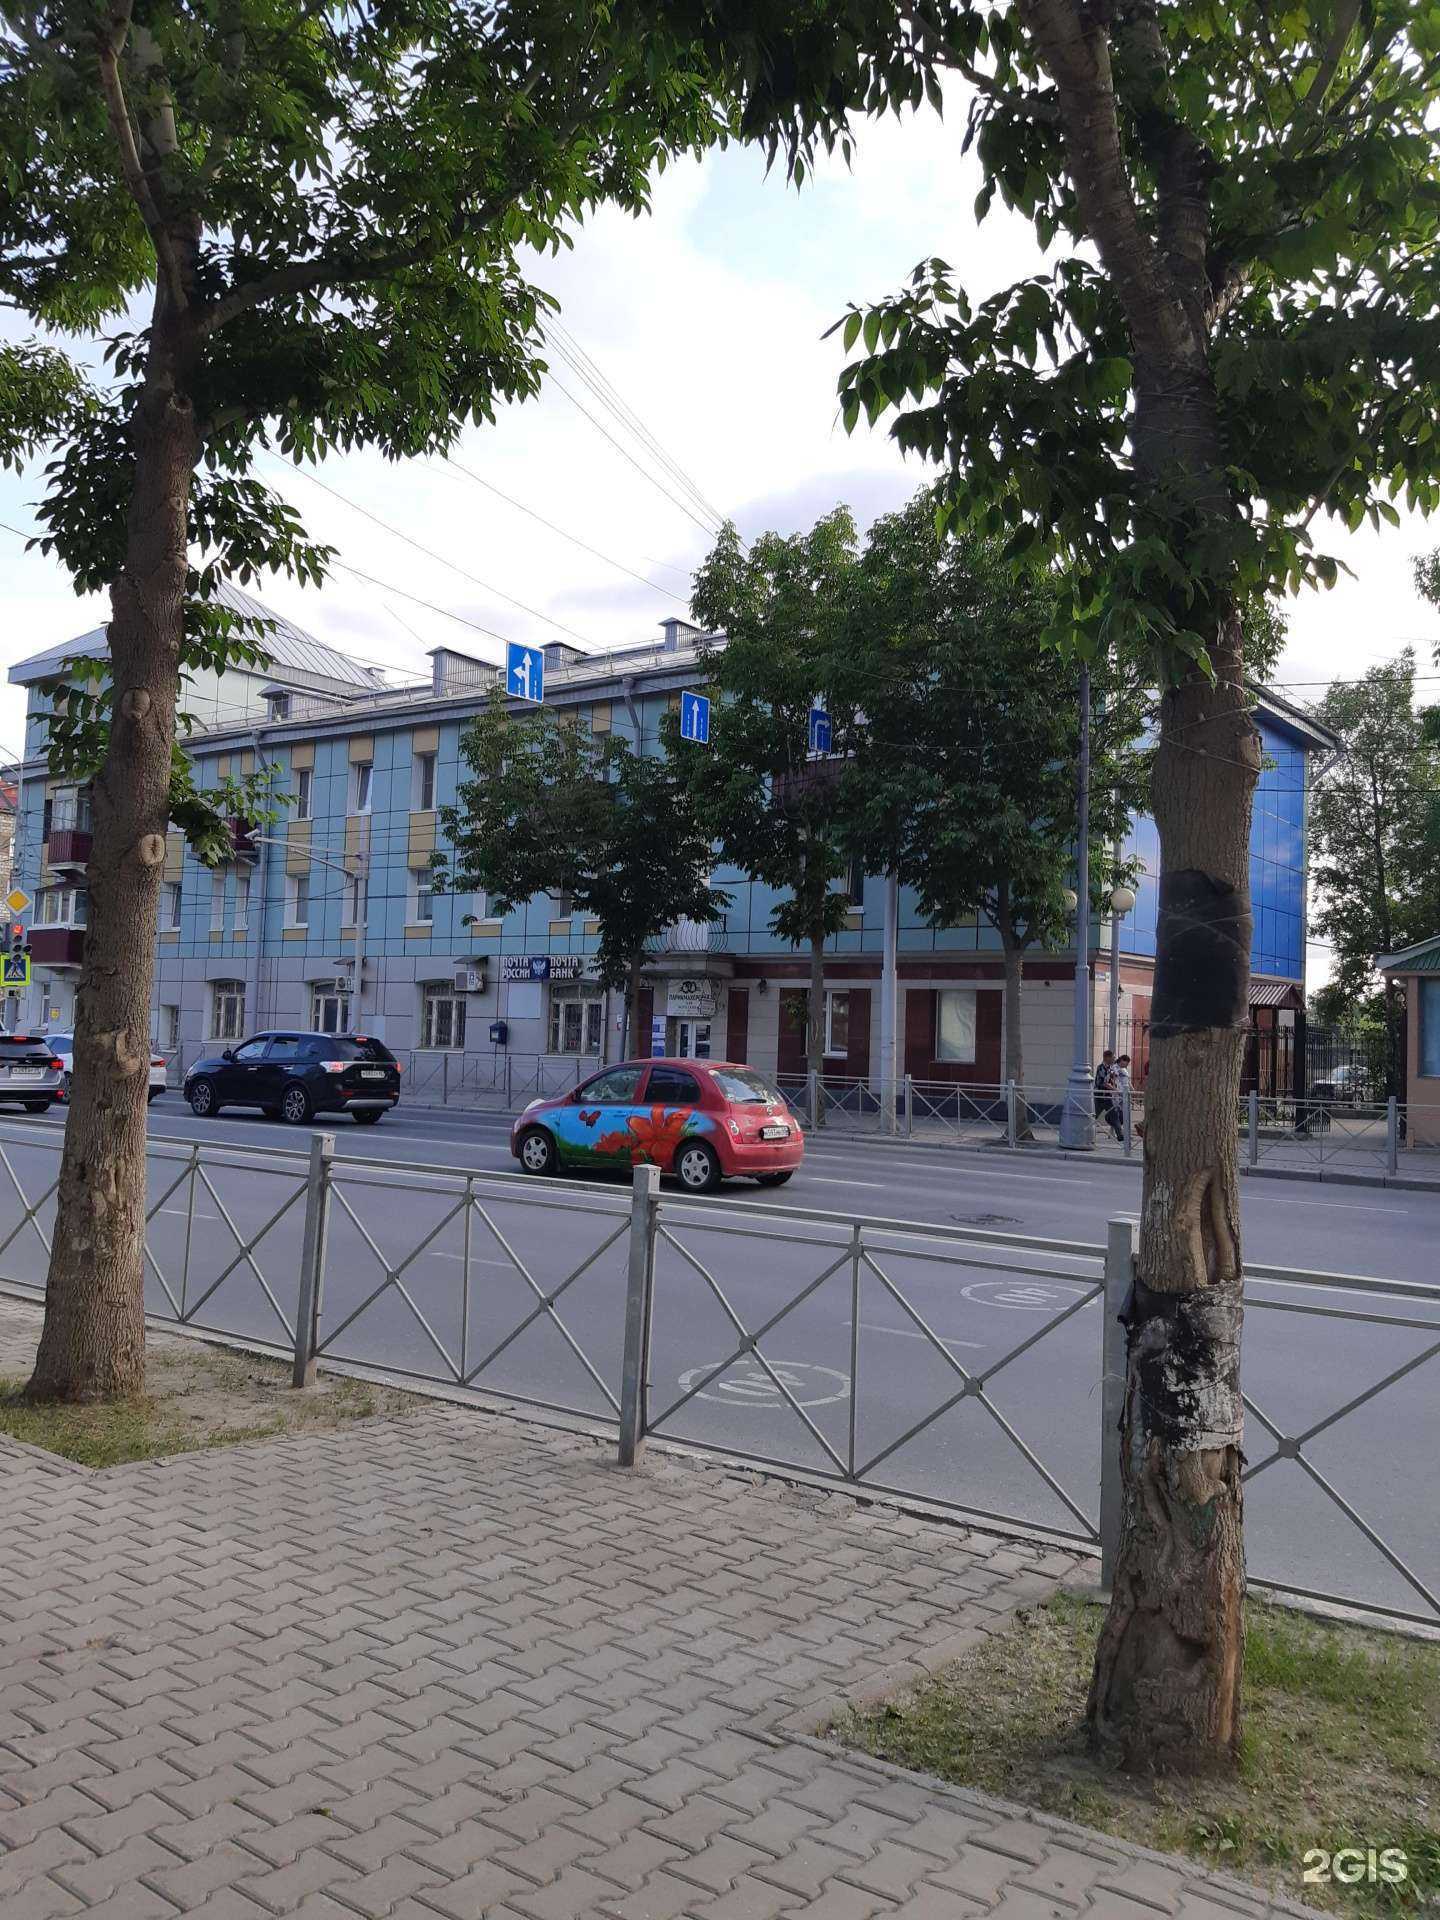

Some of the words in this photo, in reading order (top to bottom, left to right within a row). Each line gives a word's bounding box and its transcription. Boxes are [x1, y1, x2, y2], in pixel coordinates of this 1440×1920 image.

[502, 957, 529, 967] ПОЧТА
[550, 957, 578, 967] ПОЧТА
[502, 968, 531, 979] РОССИИ
[549, 968, 574, 979] БАНК
